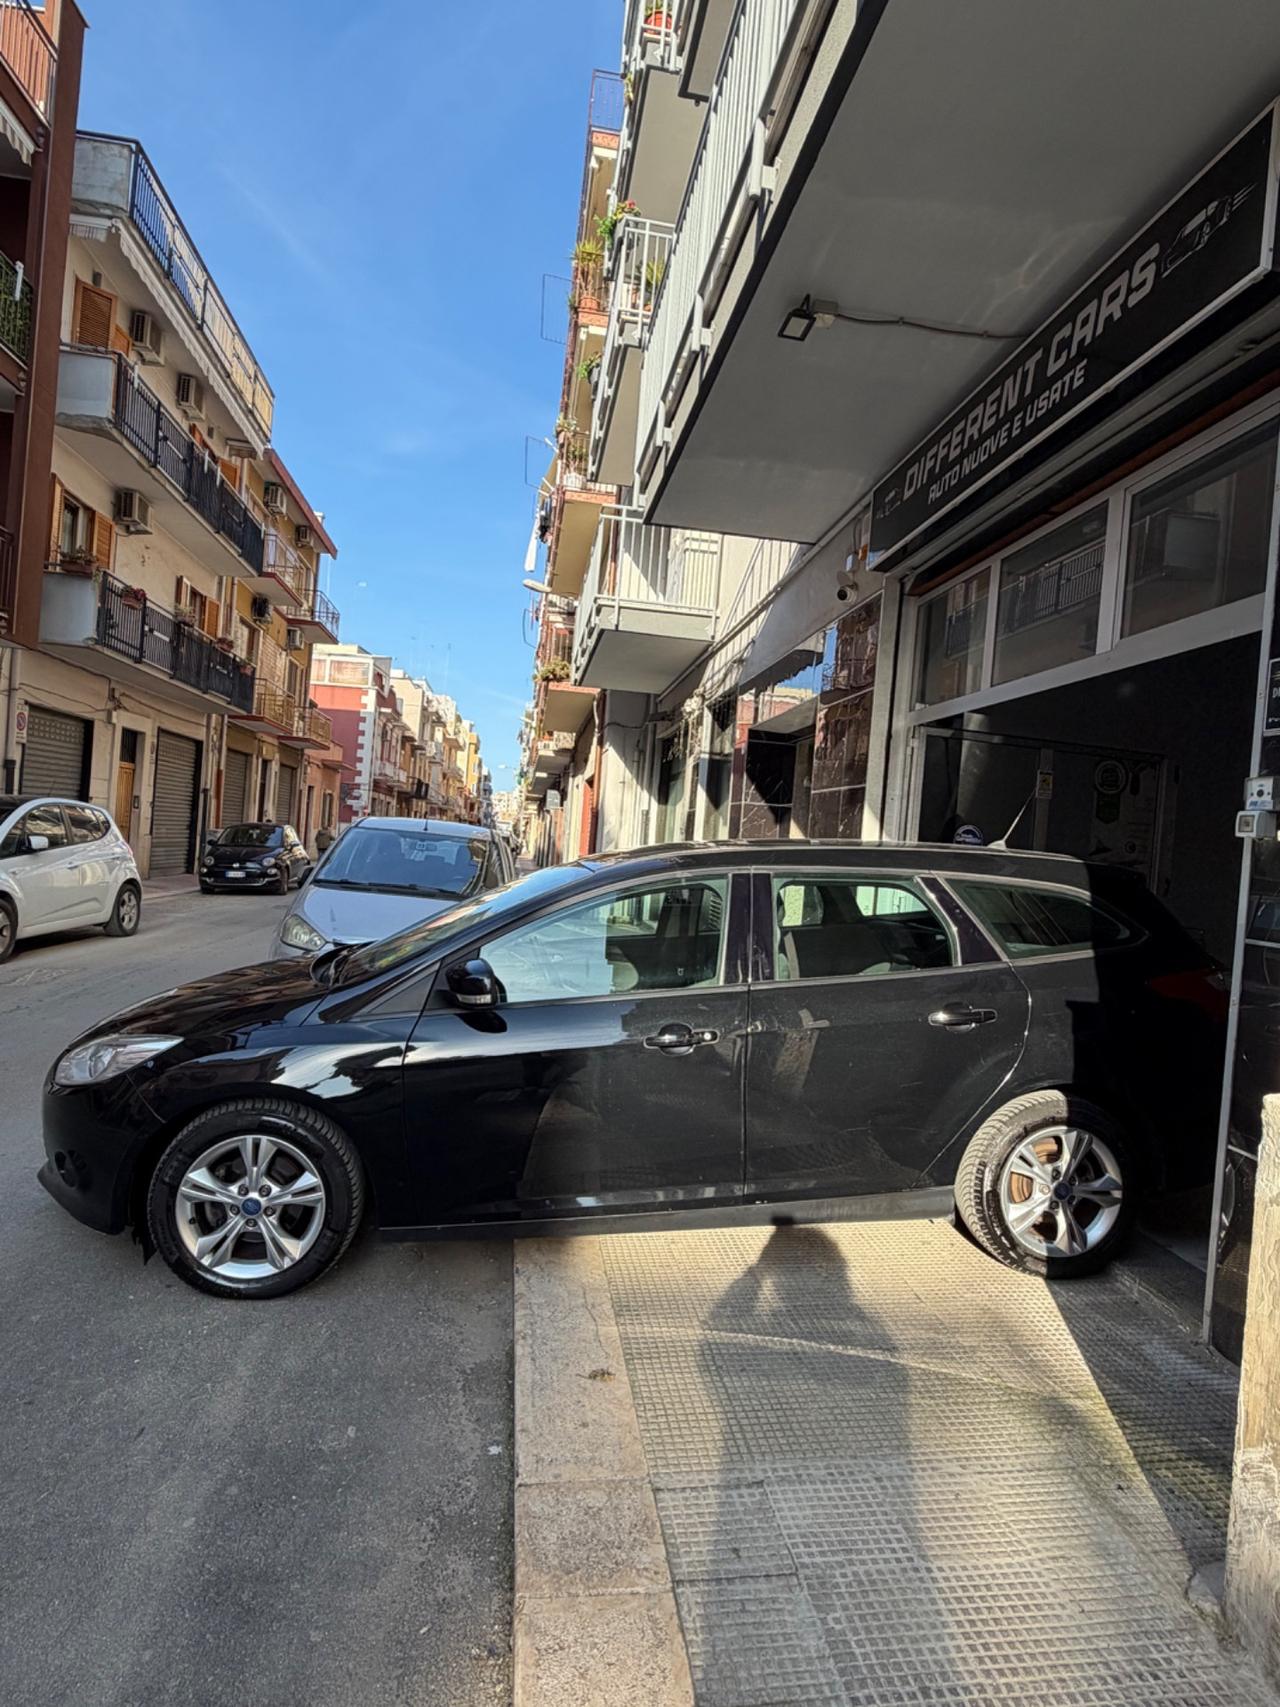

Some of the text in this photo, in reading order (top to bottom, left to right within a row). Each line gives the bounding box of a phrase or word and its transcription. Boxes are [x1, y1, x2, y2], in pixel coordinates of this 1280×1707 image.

[905, 243, 1160, 500] DIFFERENT CARS
[928, 358, 1088, 505] AUTO NUOVE E USATE
